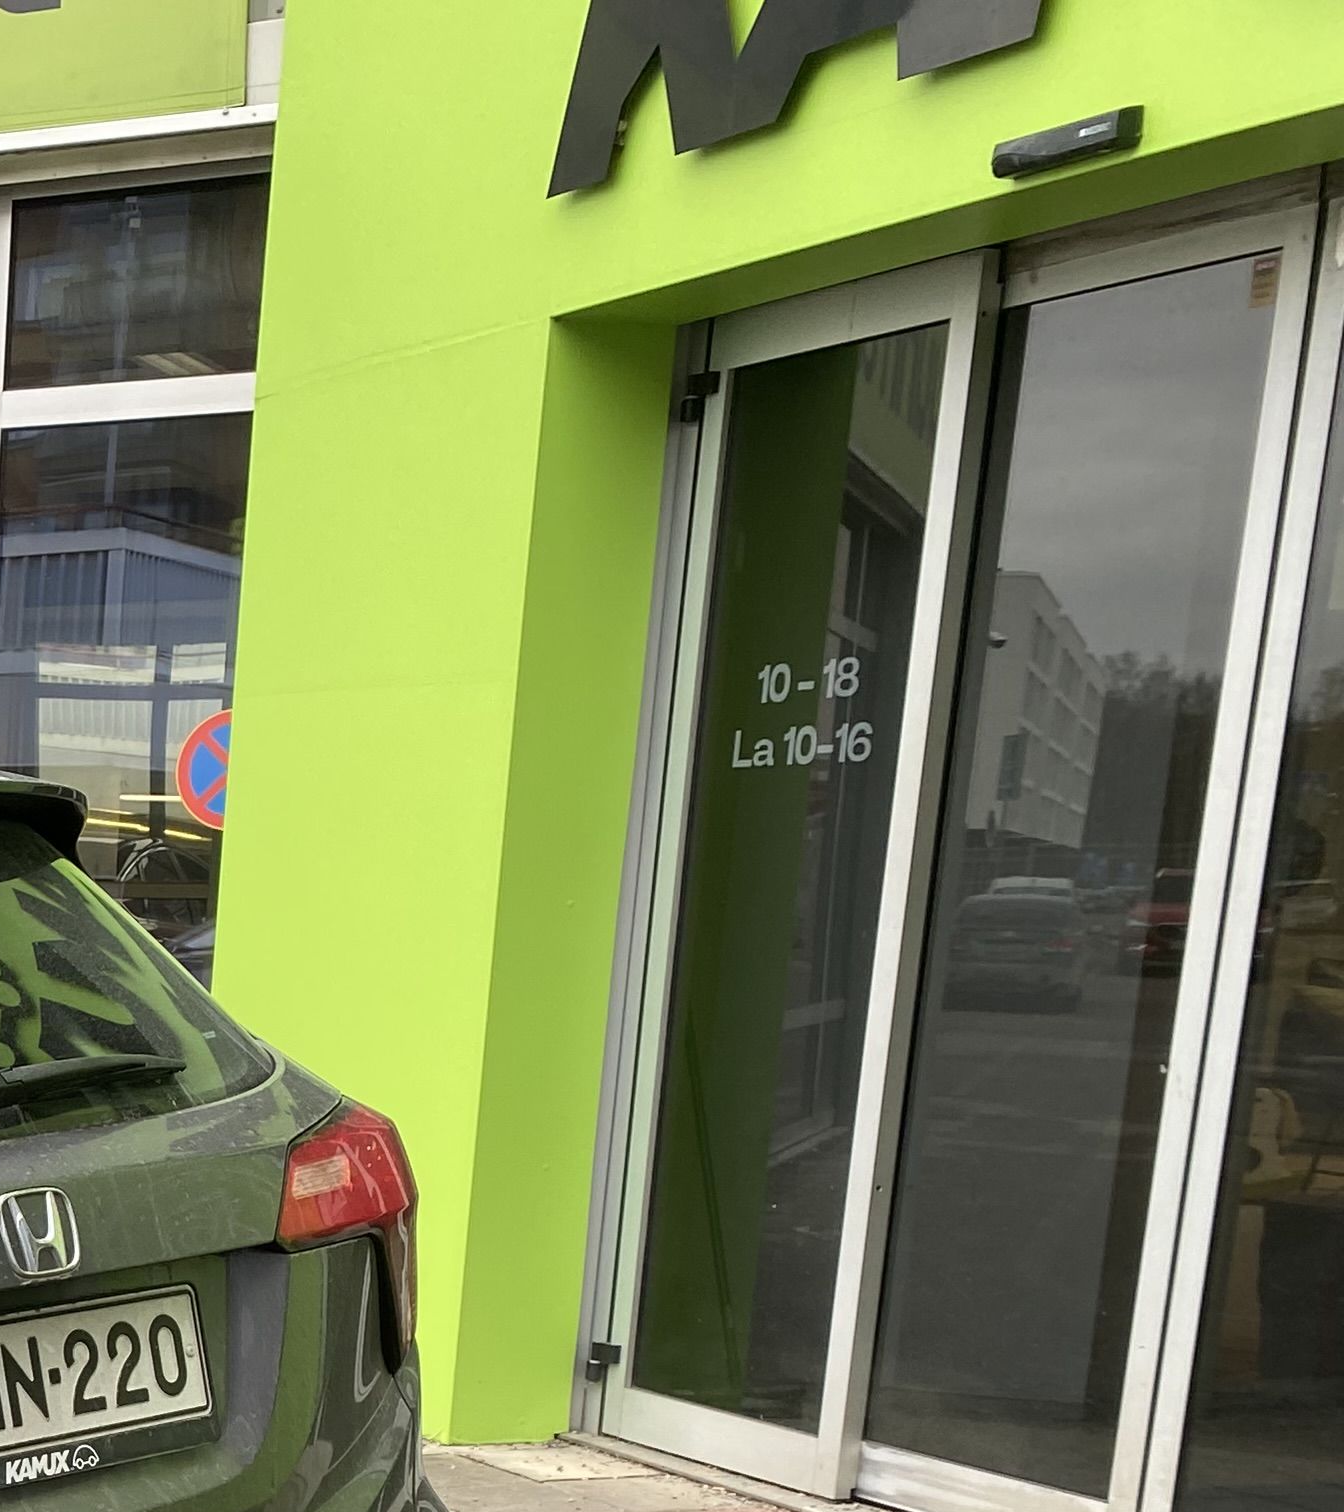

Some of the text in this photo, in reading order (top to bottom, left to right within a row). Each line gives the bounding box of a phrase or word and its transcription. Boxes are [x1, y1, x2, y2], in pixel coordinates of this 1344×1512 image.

[758, 663, 792, 704] 10
[823, 656, 861, 699] 18
[732, 721, 874, 769] La 10-16
[5, 1449, 71, 1485] KAMUX
